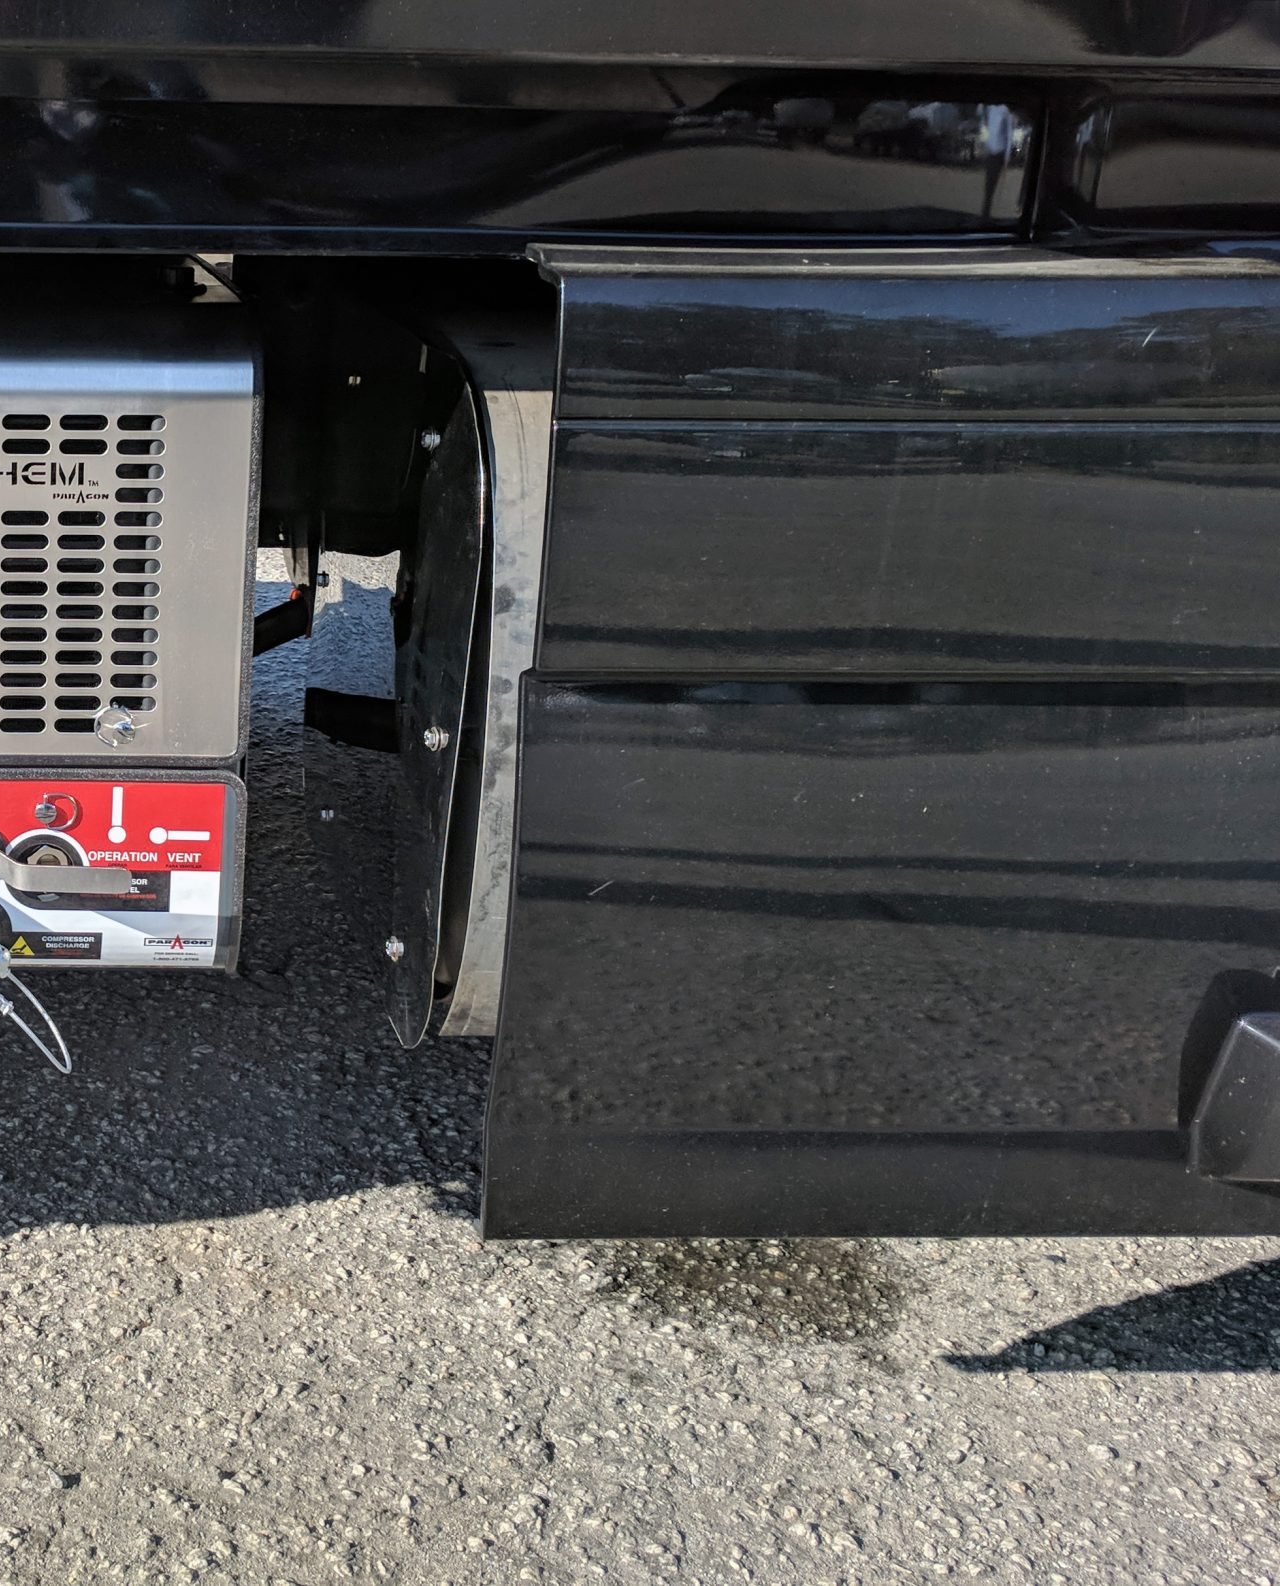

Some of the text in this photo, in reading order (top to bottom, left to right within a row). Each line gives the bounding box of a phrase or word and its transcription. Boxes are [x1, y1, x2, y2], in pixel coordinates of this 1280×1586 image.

[53, 490, 109, 503] PARAGON
[88, 850, 201, 863] OPERATION VENT
